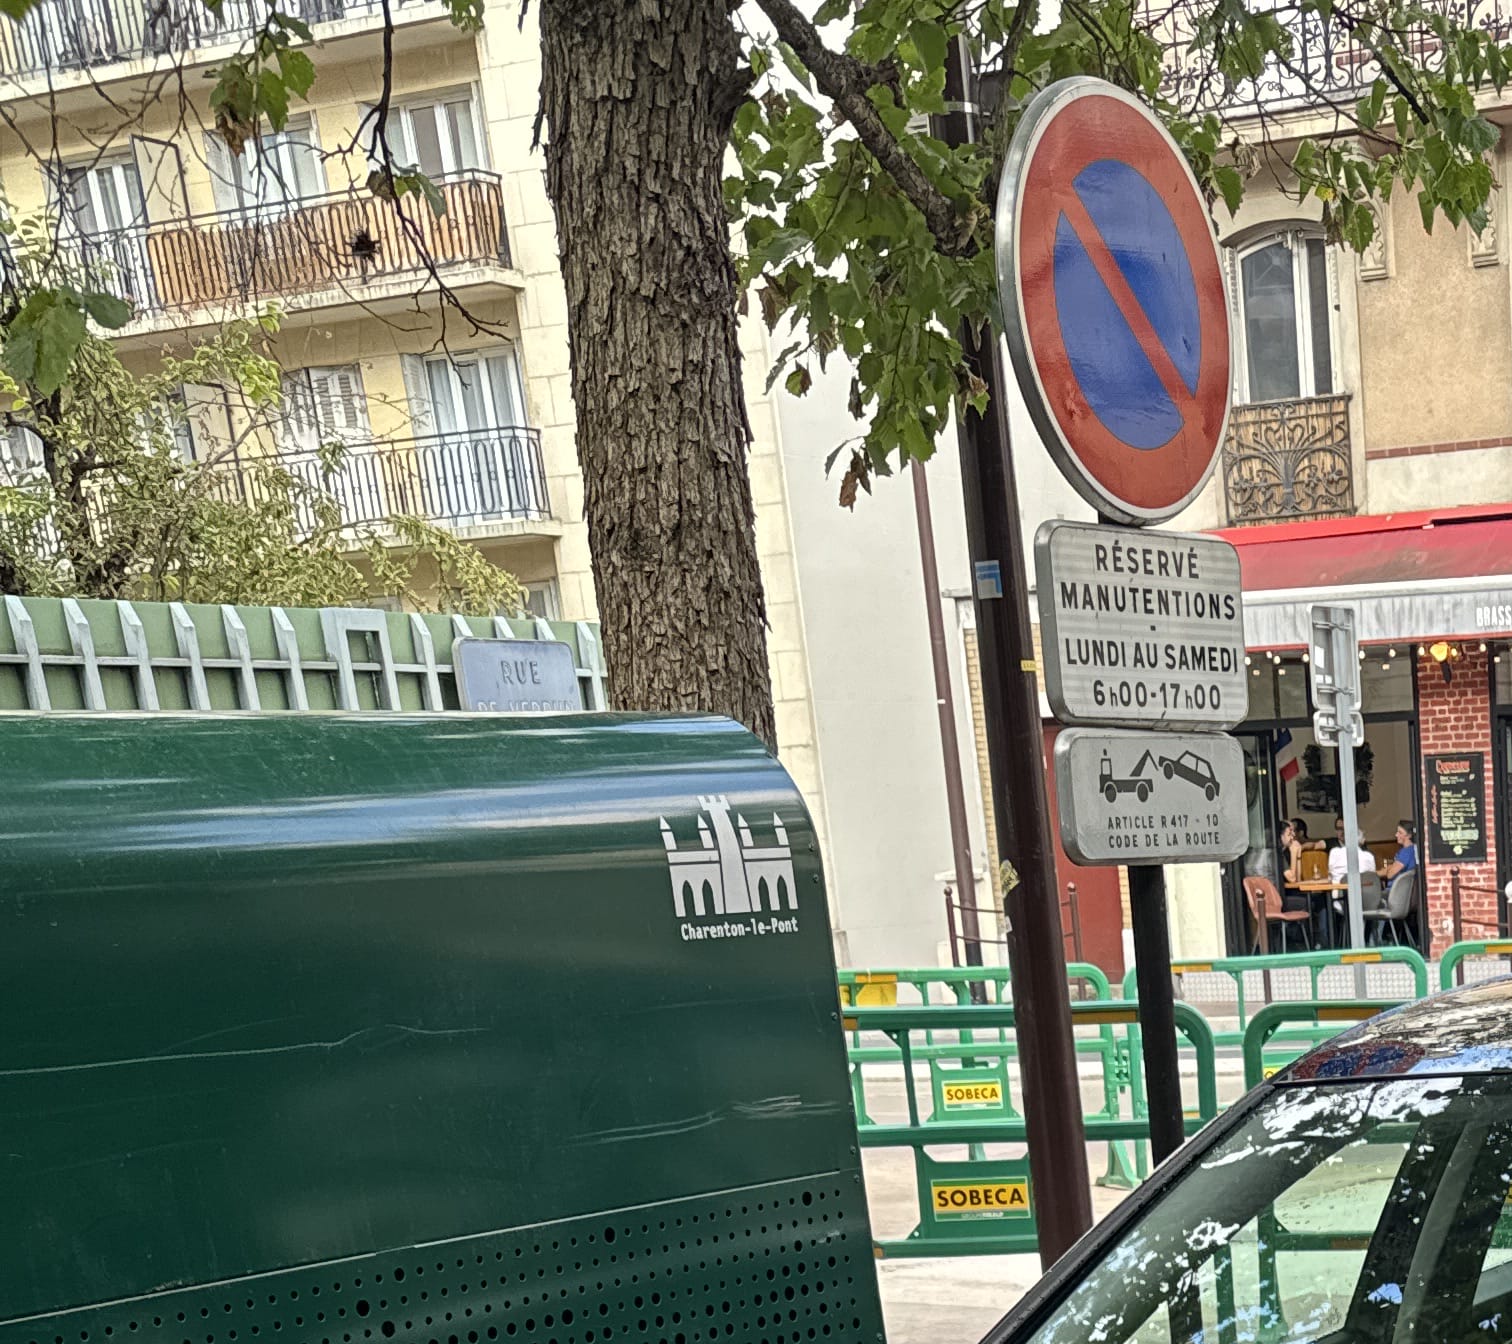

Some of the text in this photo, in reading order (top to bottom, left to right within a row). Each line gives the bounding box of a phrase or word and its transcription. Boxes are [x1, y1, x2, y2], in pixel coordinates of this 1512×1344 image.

[1095, 539, 1199, 579] RÉSERVÉ
[1060, 581, 1236, 620] MANUTENTIONS
[1065, 638, 1238, 673] LUNDI AU SAMEDI
[500, 659, 542, 686] RUE
[1108, 815, 1155, 830] ARTICLE
[1206, 813, 1219, 827] 10
[1108, 831, 1220, 848] CODE DE LA ROUTE
[680, 916, 799, 941] Charenton-le-Pont
[946, 1087, 999, 1101] SOBECA
[937, 1187, 1025, 1208] SOBECA
